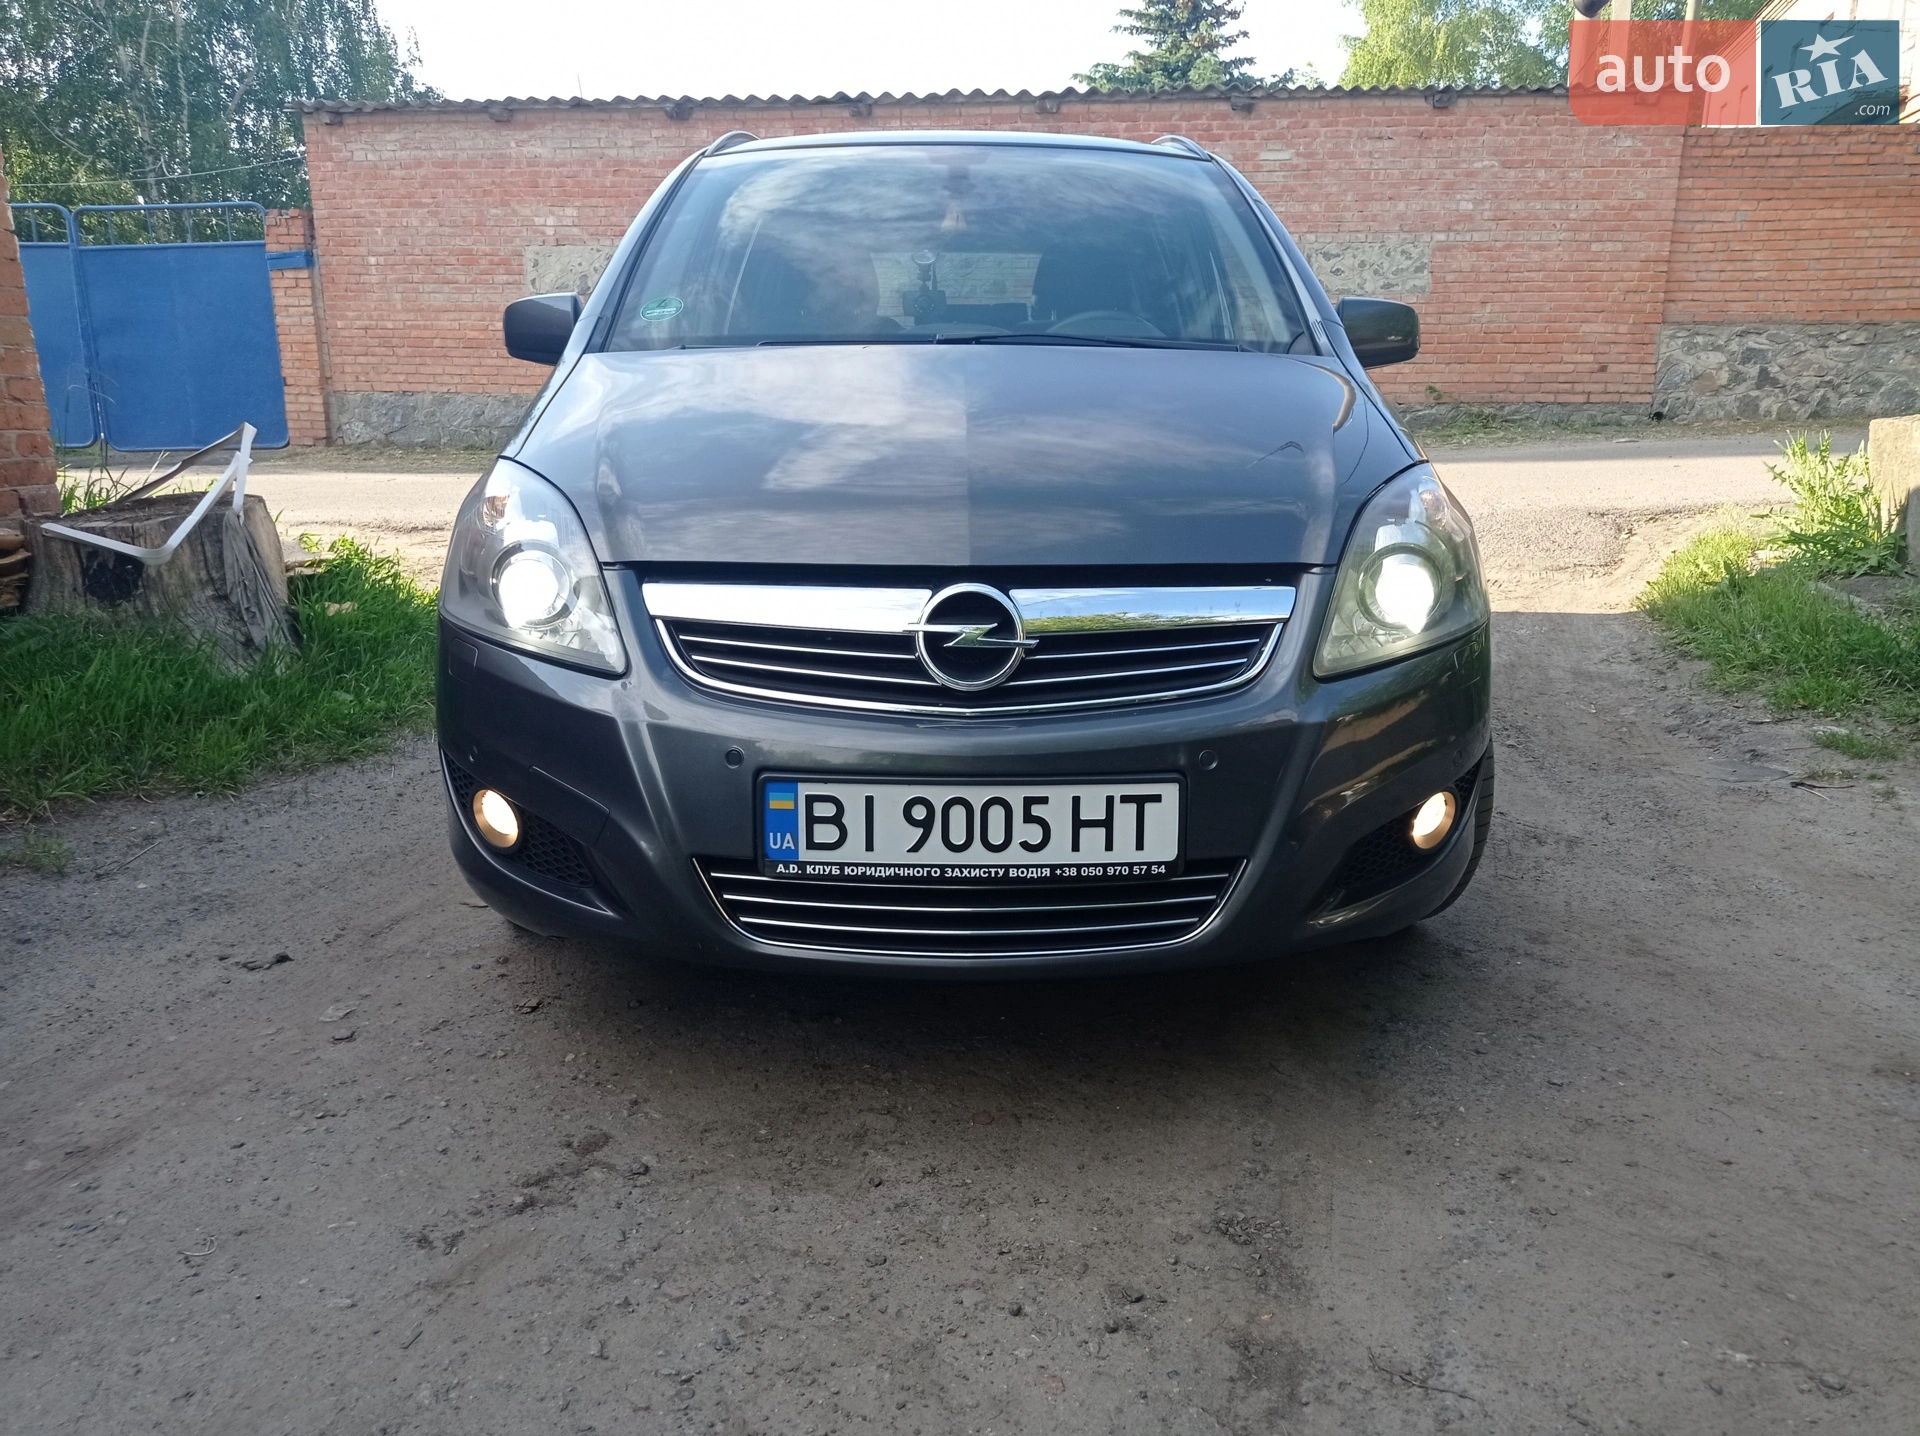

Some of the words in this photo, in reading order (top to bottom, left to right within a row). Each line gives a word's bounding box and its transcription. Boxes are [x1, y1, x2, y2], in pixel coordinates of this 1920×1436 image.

[804, 793, 875, 852] BI
[902, 795, 1052, 854] 9005
[1071, 793, 1163, 853] HT
[769, 832, 795, 850] UA
[806, 865, 841, 876] КЛУБ
[844, 865, 941, 878] ЮРИДИЧНОГО
[944, 867, 1005, 878] ЗАХИСТУ
[1009, 867, 1051, 879] ВОДІЯ
[1055, 867, 1077, 877] +38
[1081, 866, 1103, 876] 050
[1107, 866, 1129, 876] 970
[1132, 865, 1147, 875] 57
[1151, 865, 1166, 874] 54
